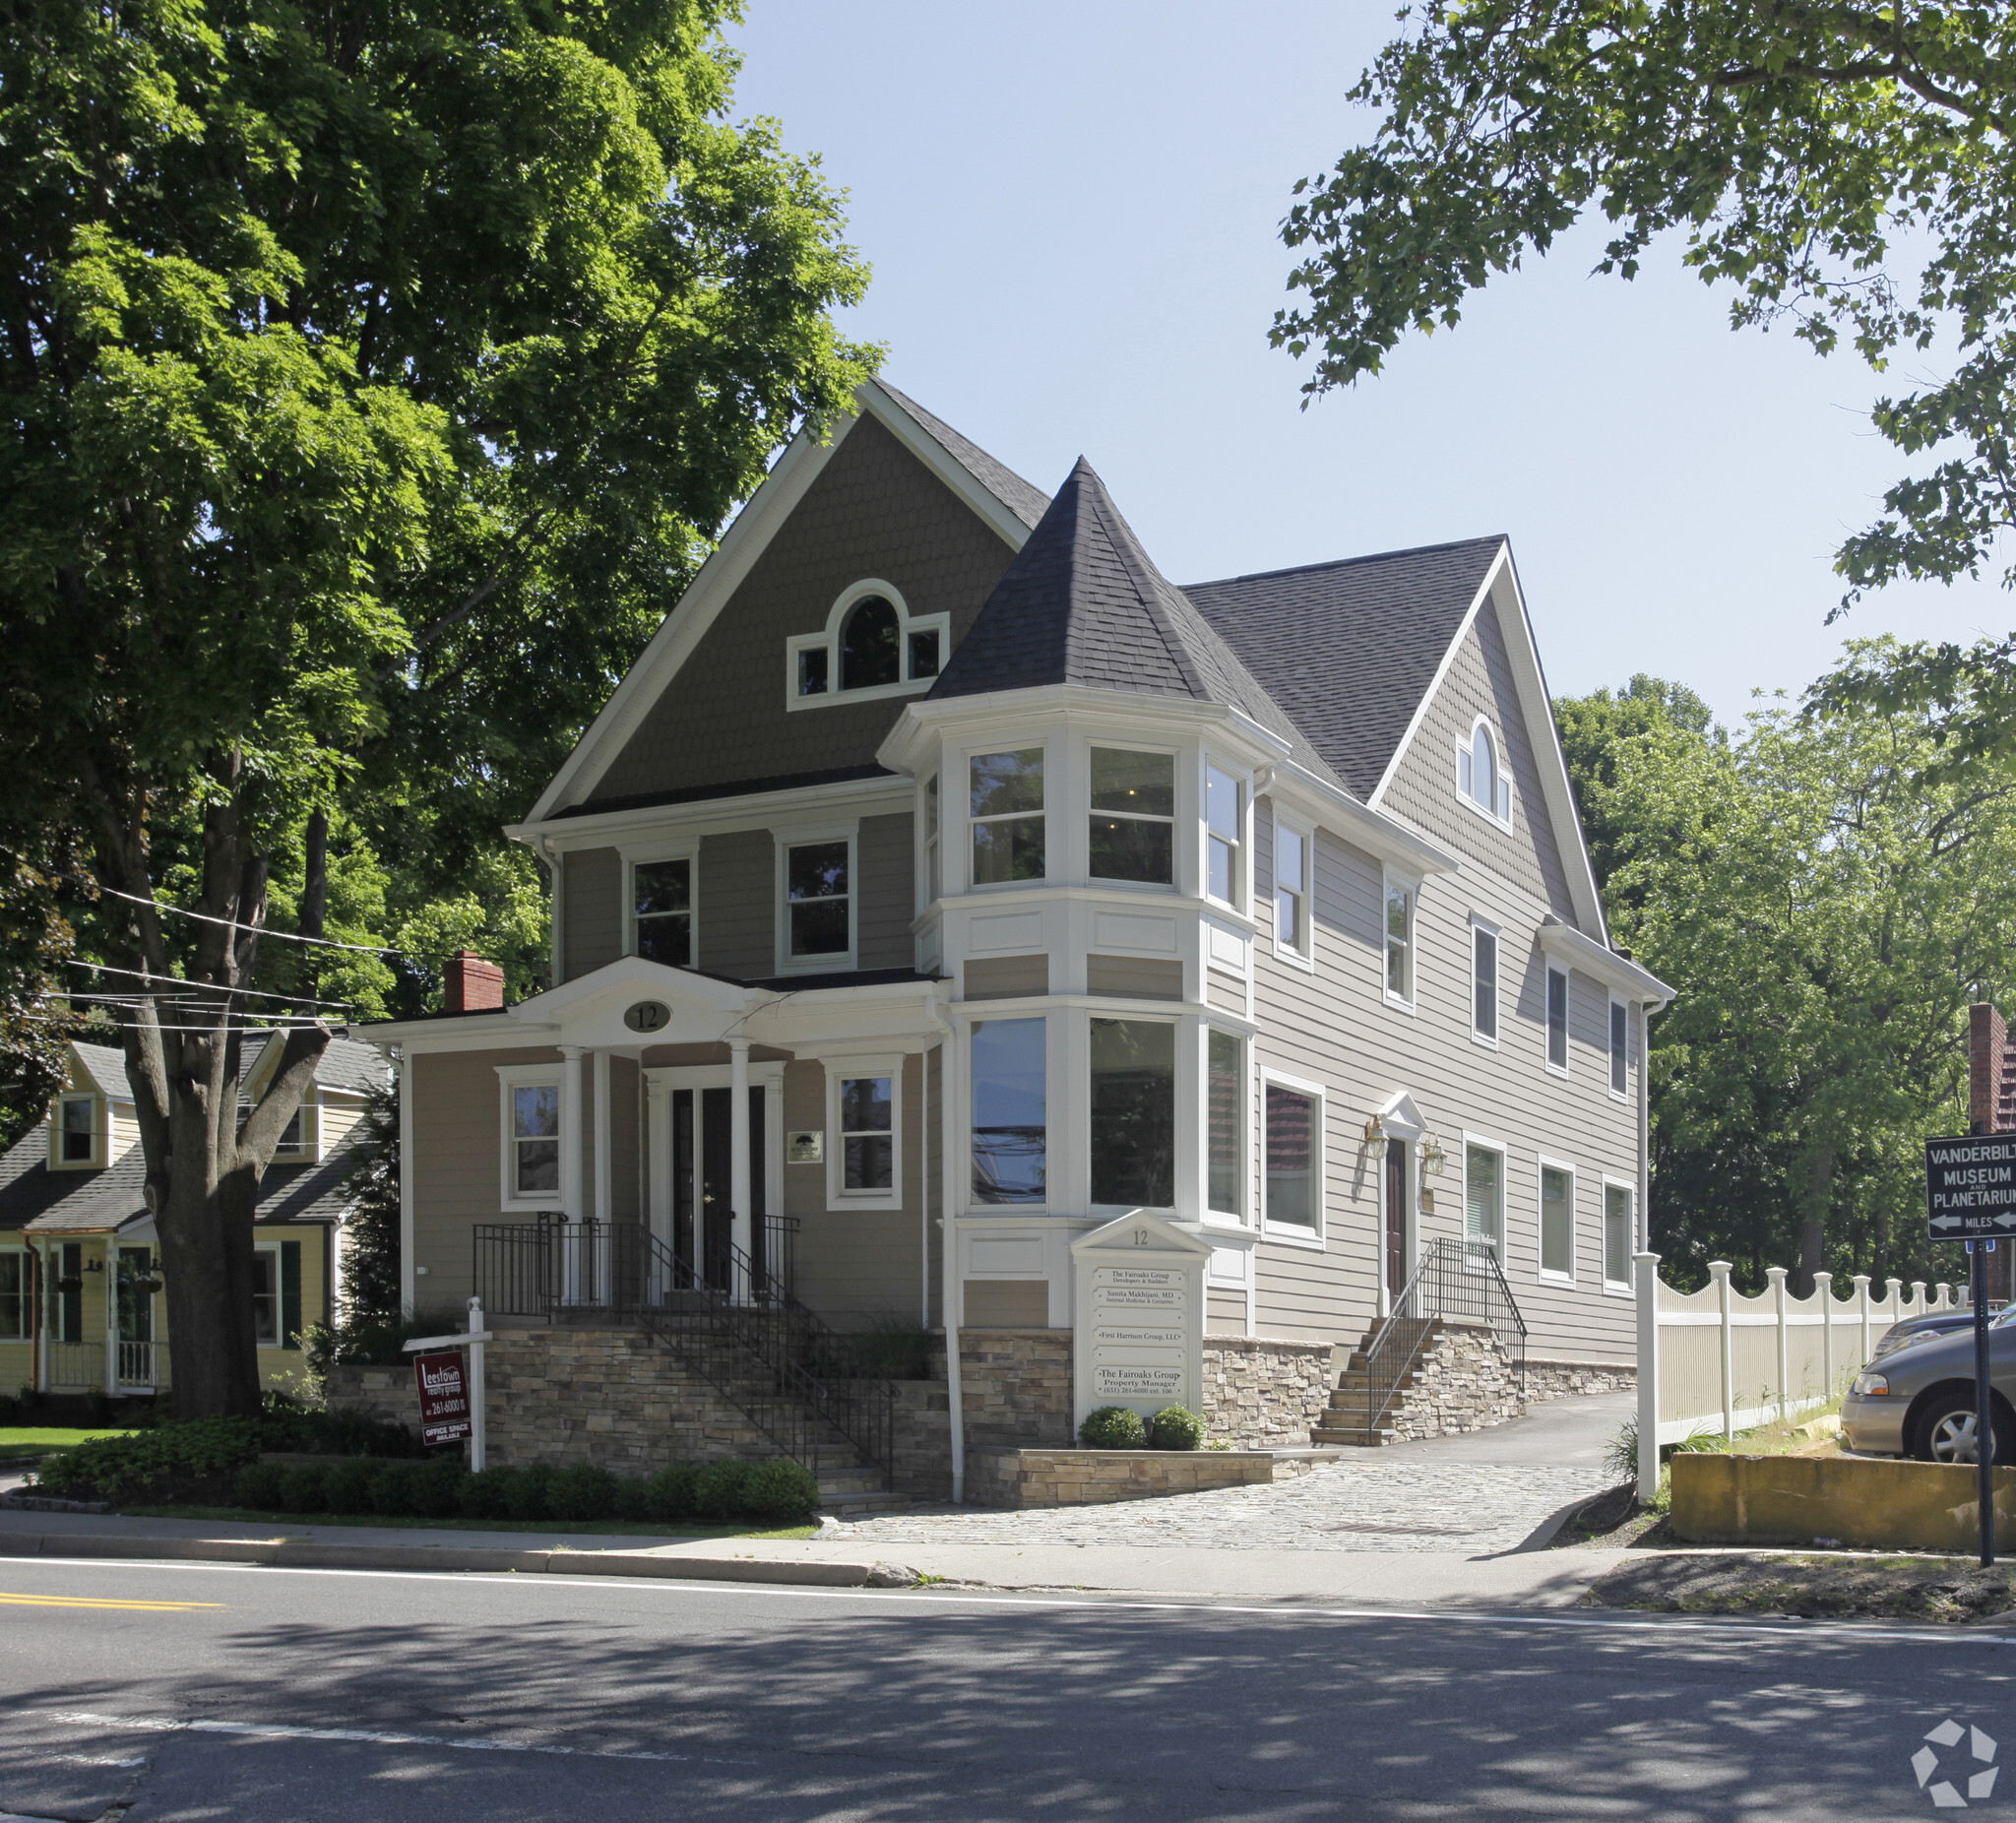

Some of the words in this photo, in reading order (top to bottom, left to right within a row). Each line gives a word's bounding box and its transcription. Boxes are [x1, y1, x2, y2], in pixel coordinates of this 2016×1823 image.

[636, 1005, 658, 1029] 12
[1944, 1166, 2011, 1186] MUSEUM
[1966, 1217, 1992, 1228] MILES
[1134, 1230, 1148, 1245] 12
[421, 1363, 461, 1389] Leestown
[1102, 1369, 1116, 1378] The
[1118, 1370, 1152, 1379] Fairoaks
[1154, 1370, 1179, 1381] Group
[427, 1386, 445, 1396] realty
[445, 1384, 462, 1396] group
[425, 1426, 448, 1437] OFFICE
[449, 1423, 469, 1433] SPACE
